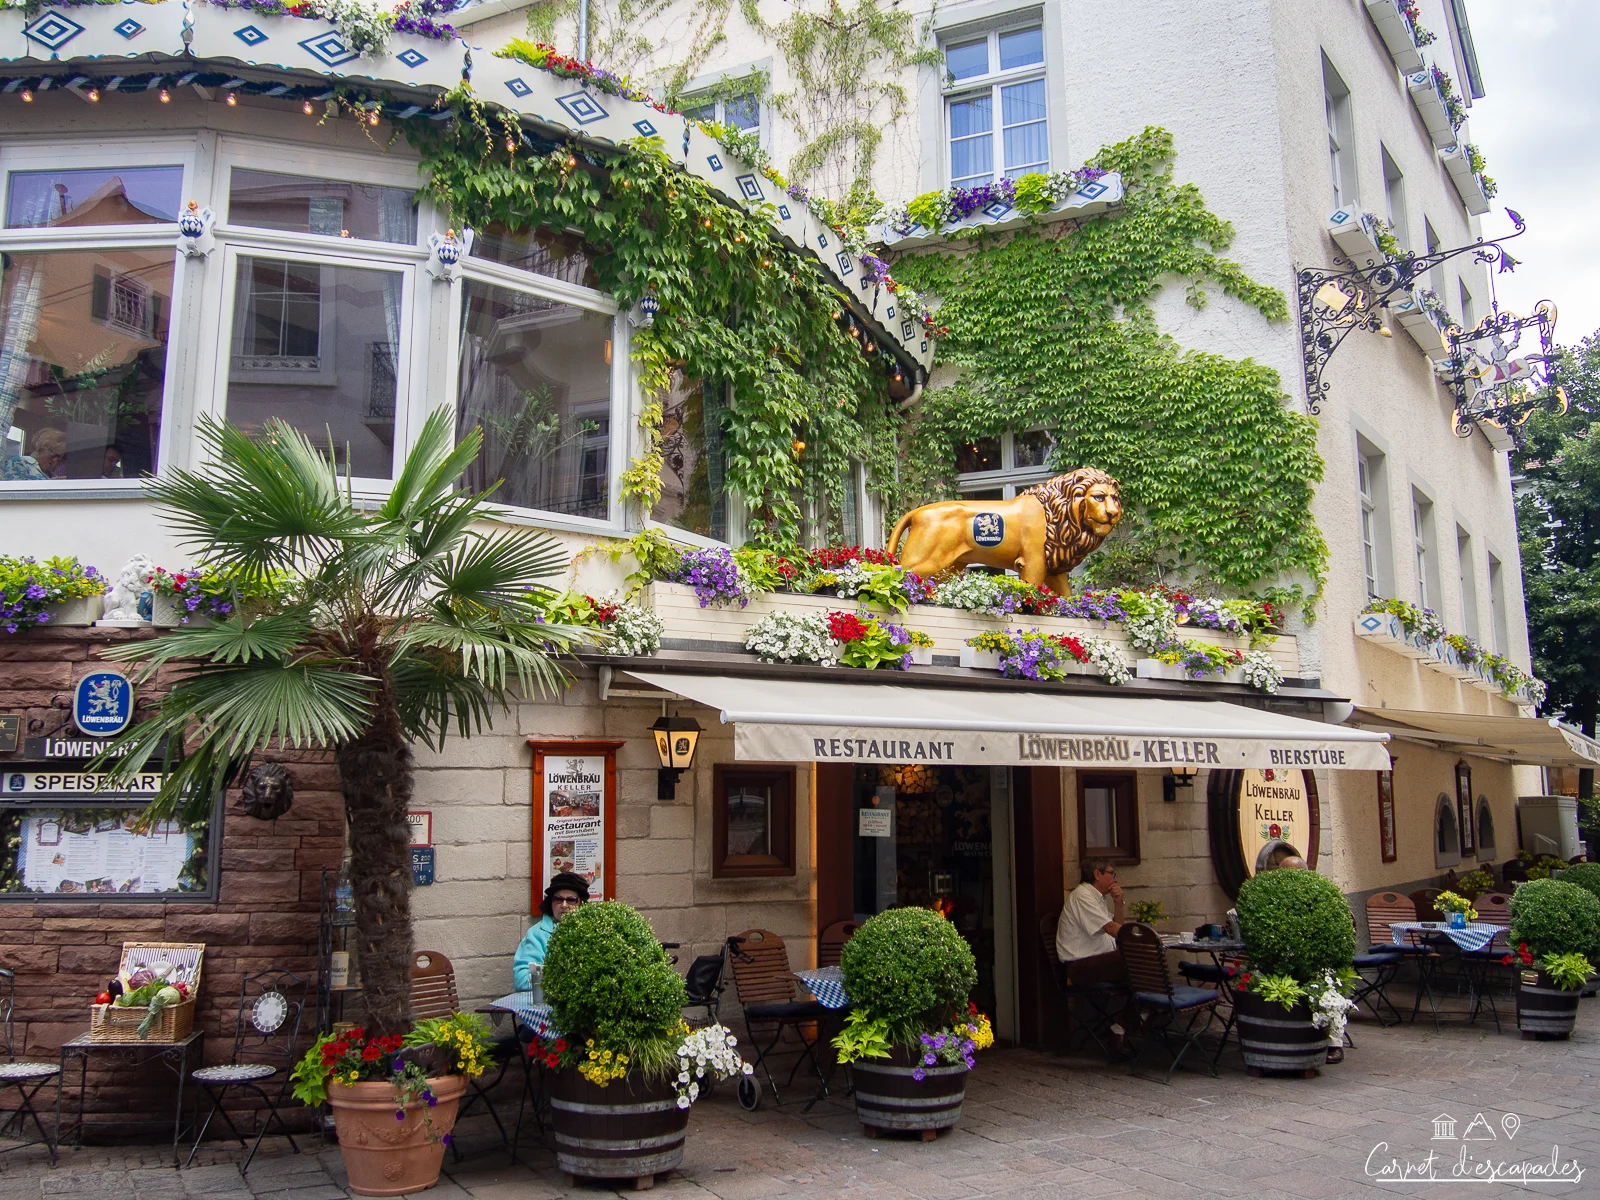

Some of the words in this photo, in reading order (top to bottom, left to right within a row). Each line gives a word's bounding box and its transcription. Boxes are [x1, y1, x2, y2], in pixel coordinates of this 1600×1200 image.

[82, 714, 124, 724] LÖWENBRÄU
[45, 737, 143, 757] LÖWENBRÄ
[813, 738, 955, 760] RESTAURANT
[1269, 749, 1346, 765] BIERSTUBE
[548, 773, 601, 784] LÖWENBRÄU
[1246, 780, 1300, 800] LÖWENBRÄU
[1255, 804, 1294, 822] KELLER
[547, 819, 602, 831] Restaurant
